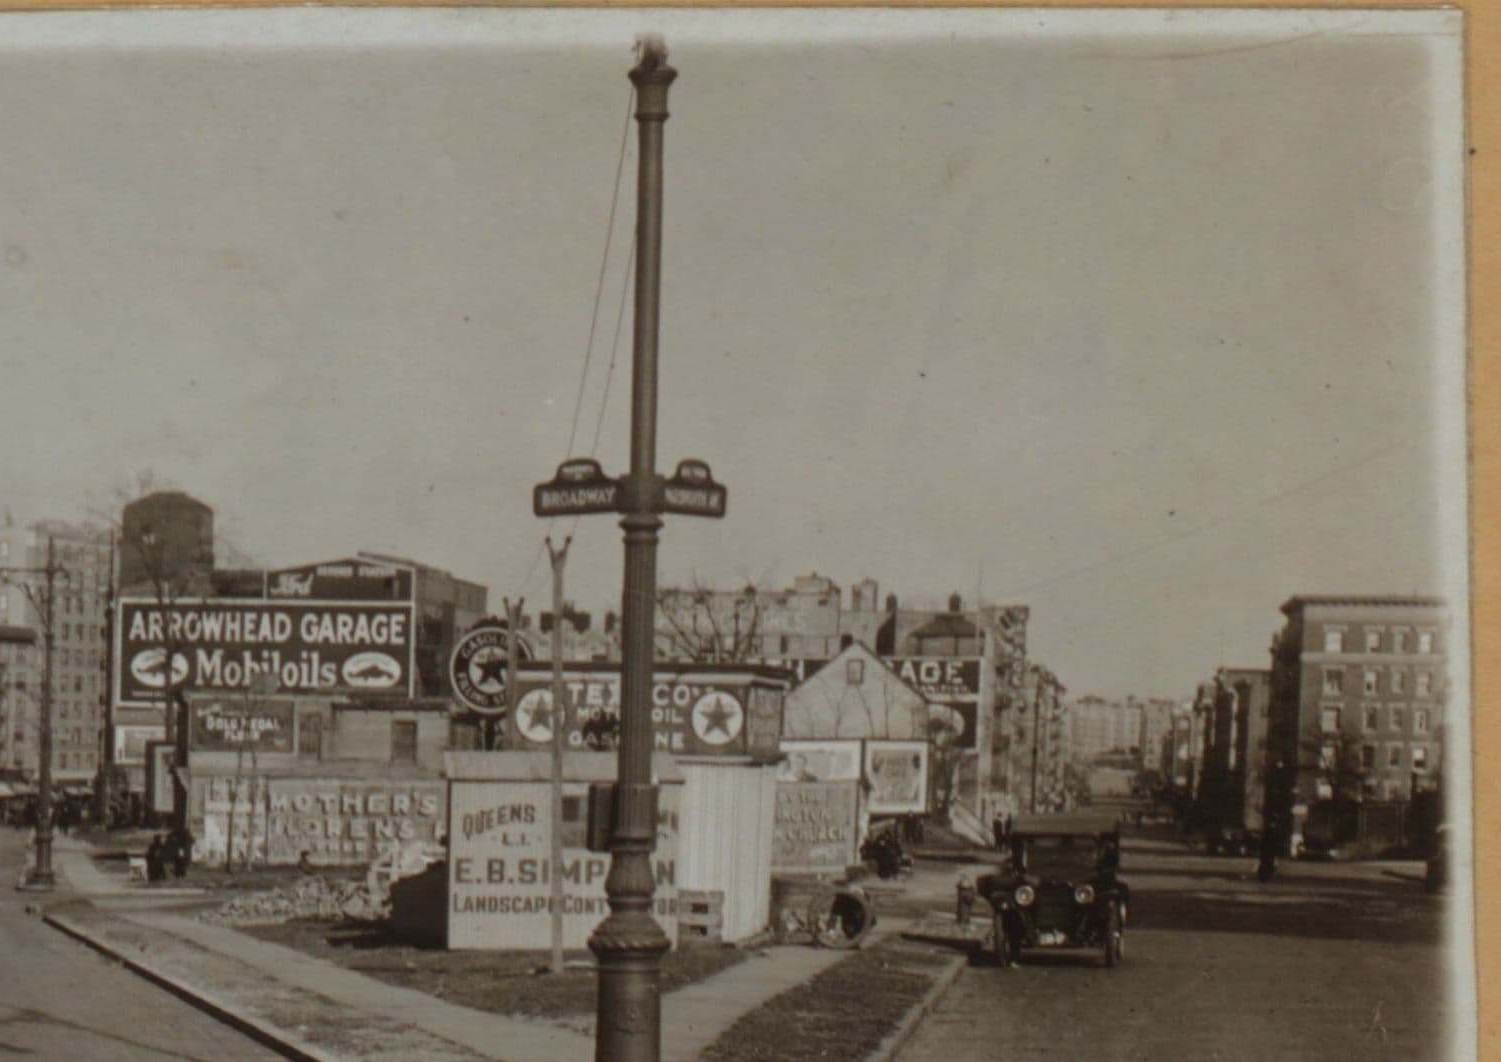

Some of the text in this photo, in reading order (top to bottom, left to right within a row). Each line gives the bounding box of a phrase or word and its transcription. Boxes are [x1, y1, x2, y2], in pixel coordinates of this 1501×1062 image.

[541, 487, 616, 508] BROADWAY
[129, 611, 406, 645] ARROWHEAD GARAGE
[195, 648, 337, 688] Mobiloils
[651, 704, 684, 724] OIL
[269, 791, 437, 816] MOTHER'S
[462, 804, 536, 840] QUEENS
